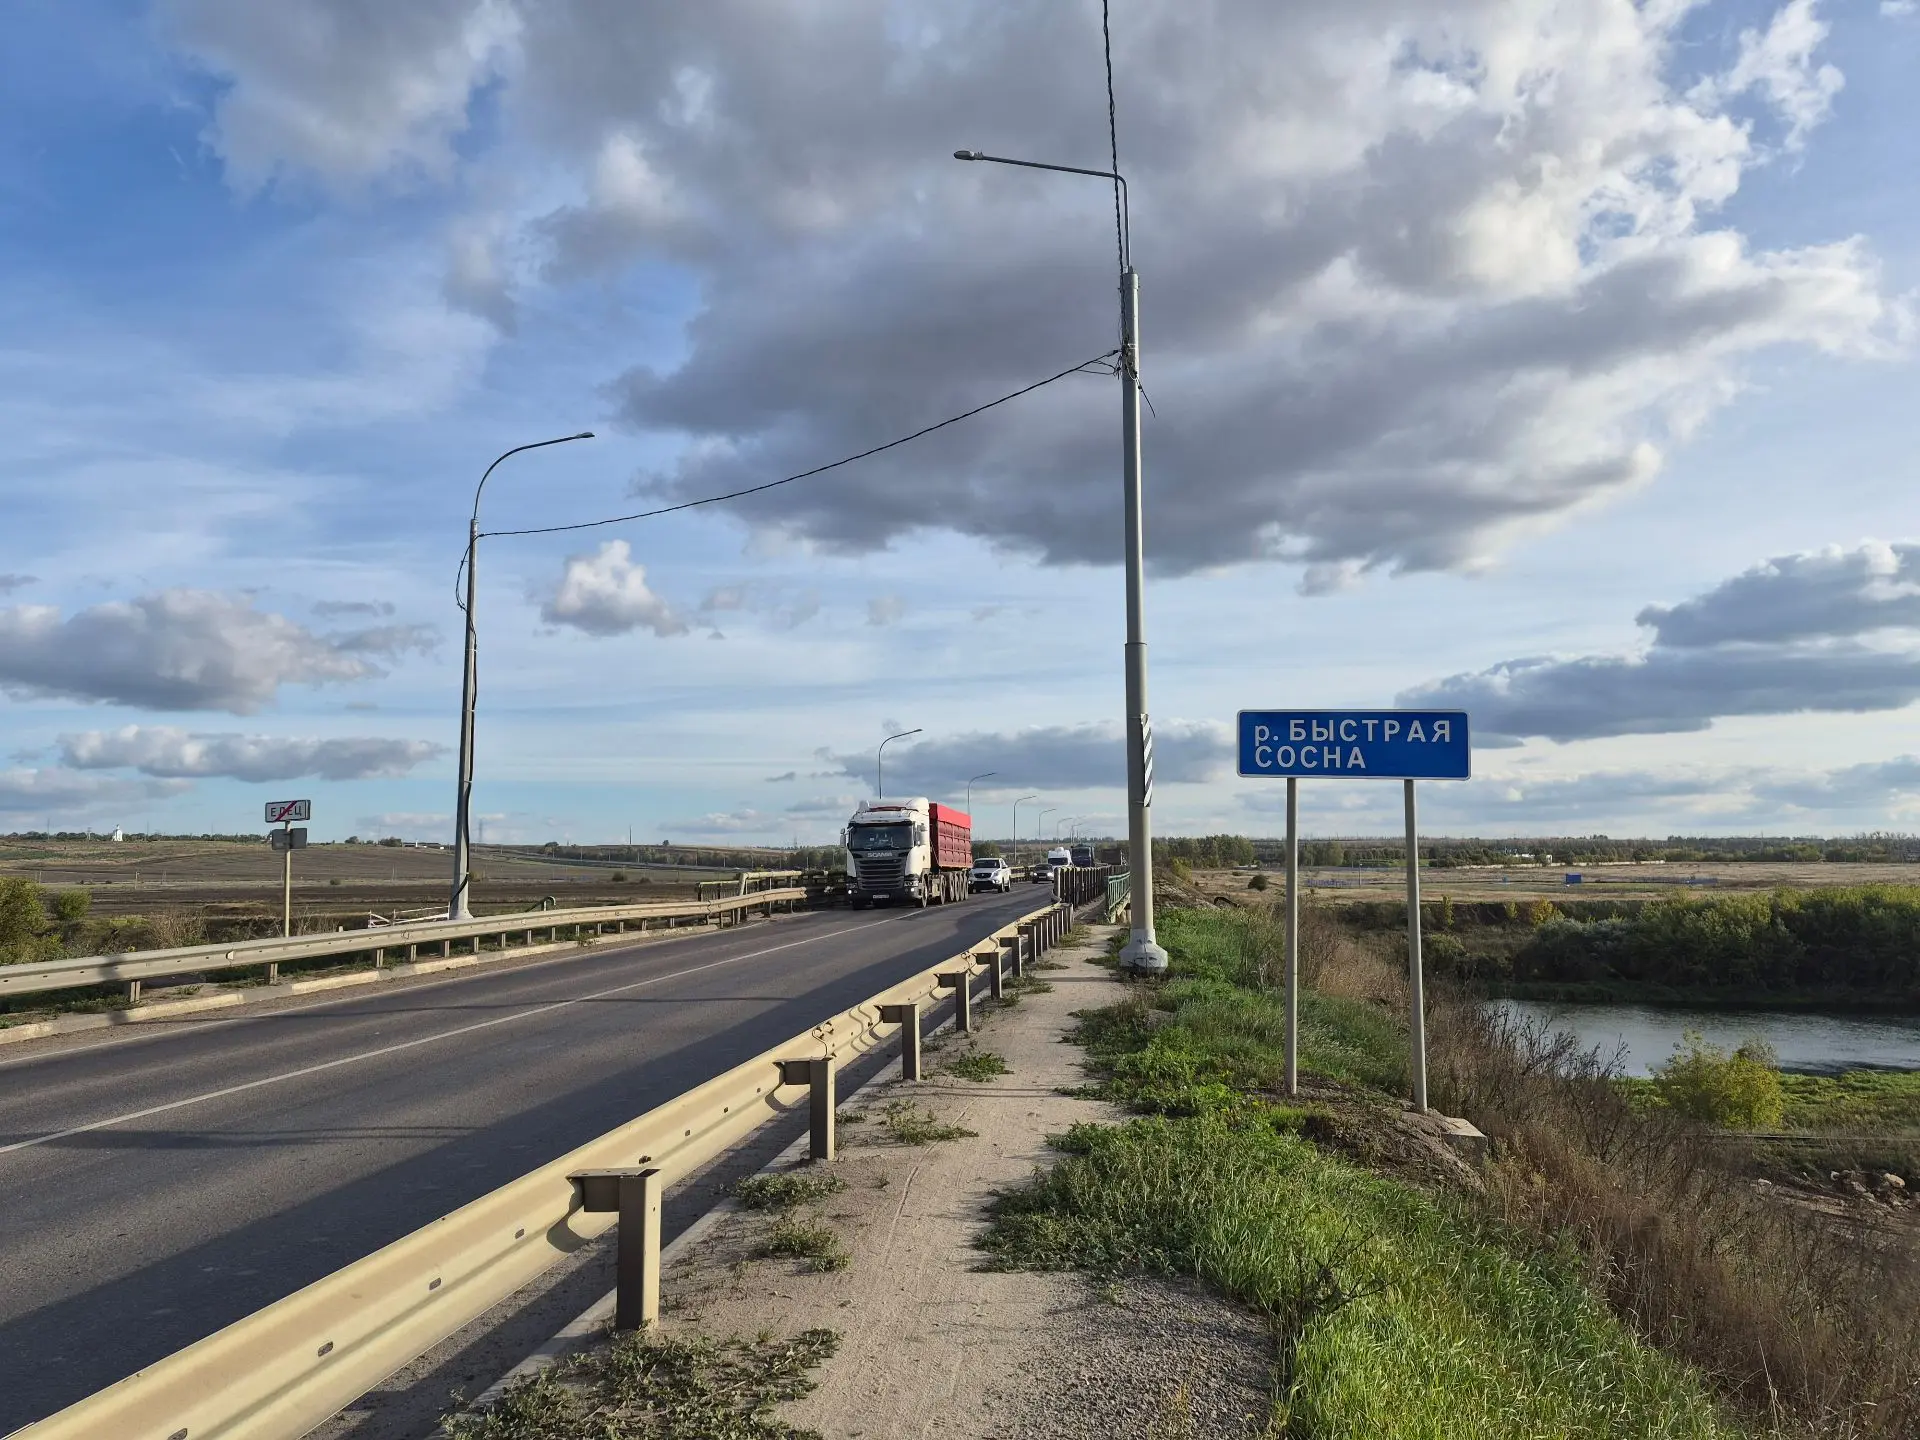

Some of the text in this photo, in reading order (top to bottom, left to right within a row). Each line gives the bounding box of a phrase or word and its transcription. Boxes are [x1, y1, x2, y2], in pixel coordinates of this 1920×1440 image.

[1254, 719, 1450, 746] р. БЫСТРАЯ
[1255, 746, 1366, 768] СОСНА
